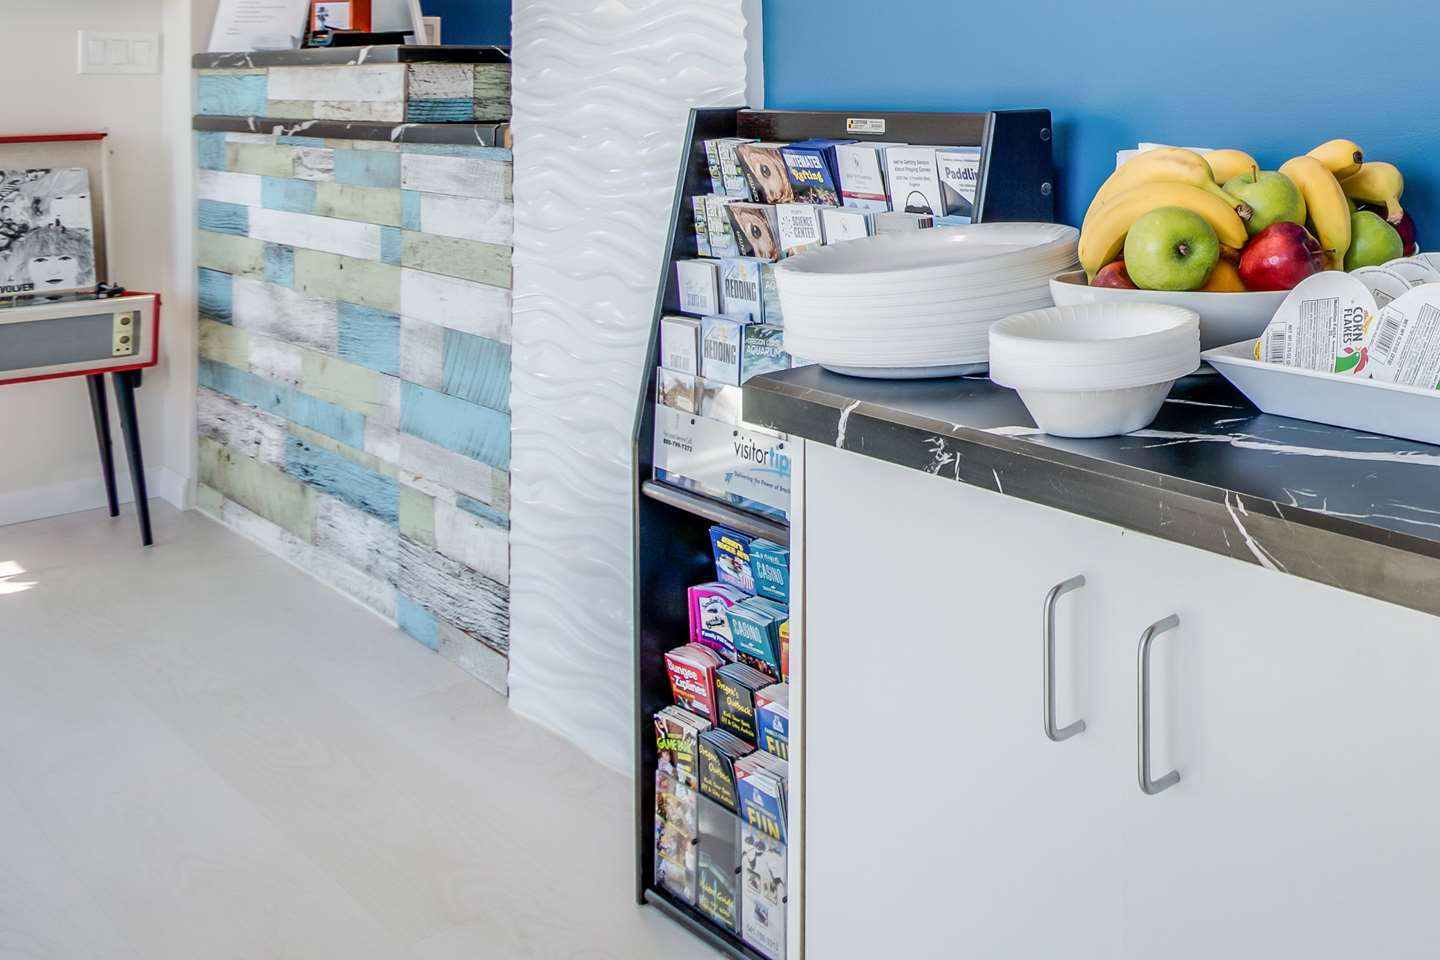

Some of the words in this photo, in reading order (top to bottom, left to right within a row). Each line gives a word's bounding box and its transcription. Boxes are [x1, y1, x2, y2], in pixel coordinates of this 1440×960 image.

[945, 166, 978, 181] Paddli
[794, 227, 816, 239] CENTER
[0, 283, 34, 294] VOLVER
[725, 278, 757, 302] REDDING
[1344, 308, 1352, 344] FLAKES
[1353, 306, 1363, 342] CORN
[704, 339, 736, 365] REDDING
[734, 436, 791, 473] visitortip
[757, 561, 784, 586] CASINO
[733, 618, 762, 643] CASINO
[666, 658, 698, 681] Bungee
[747, 806, 780, 841] FUN
